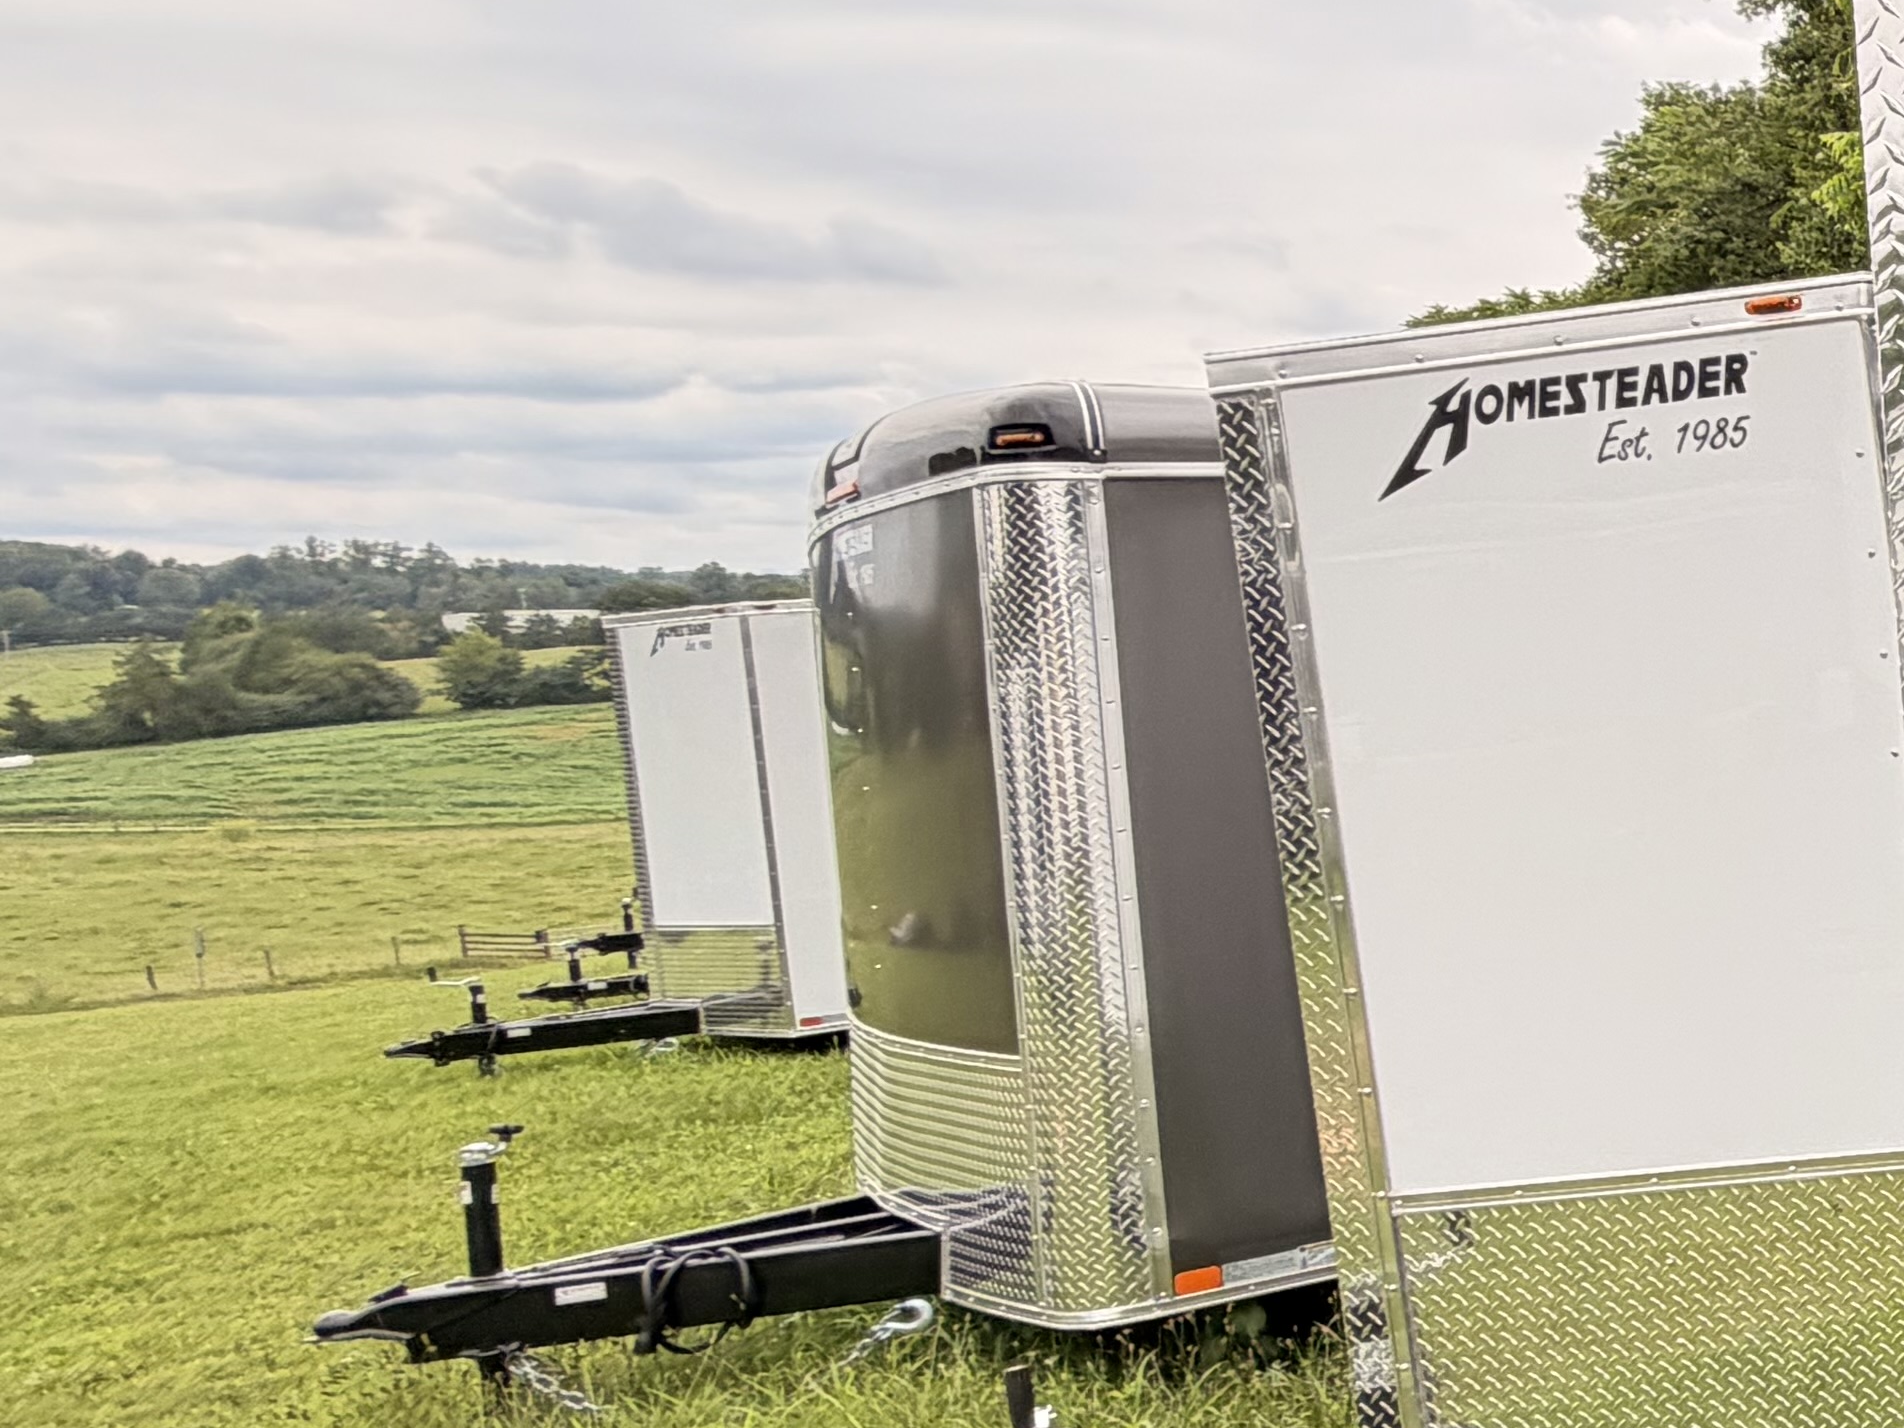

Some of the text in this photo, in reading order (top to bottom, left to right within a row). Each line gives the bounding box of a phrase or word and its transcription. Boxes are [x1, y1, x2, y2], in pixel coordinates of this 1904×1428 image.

[1377, 352, 1749, 503] HOMESTEADER
[1597, 414, 1751, 464] Est. 1985
